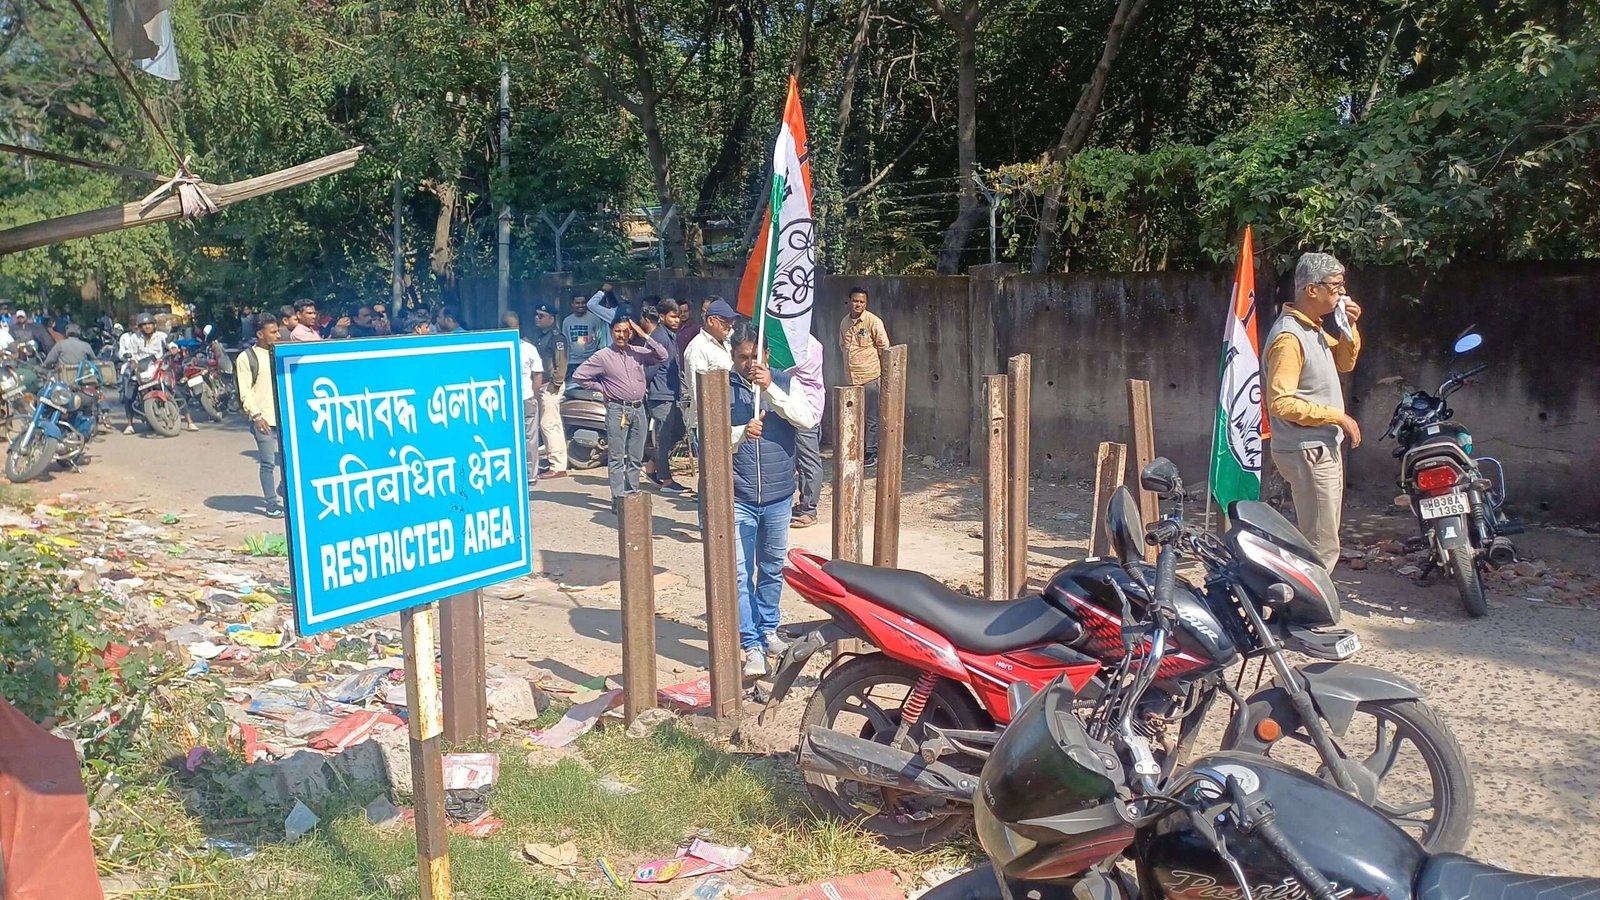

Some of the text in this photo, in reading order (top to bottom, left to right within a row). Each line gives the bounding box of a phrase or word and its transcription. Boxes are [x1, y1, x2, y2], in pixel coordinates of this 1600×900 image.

[307, 374, 507, 444] সীমাবদ্ধ এলাকা
[310, 435, 511, 521] प्रतिबंधित क्षेत्र
[320, 505, 515, 591] RESTRICTED AREA
